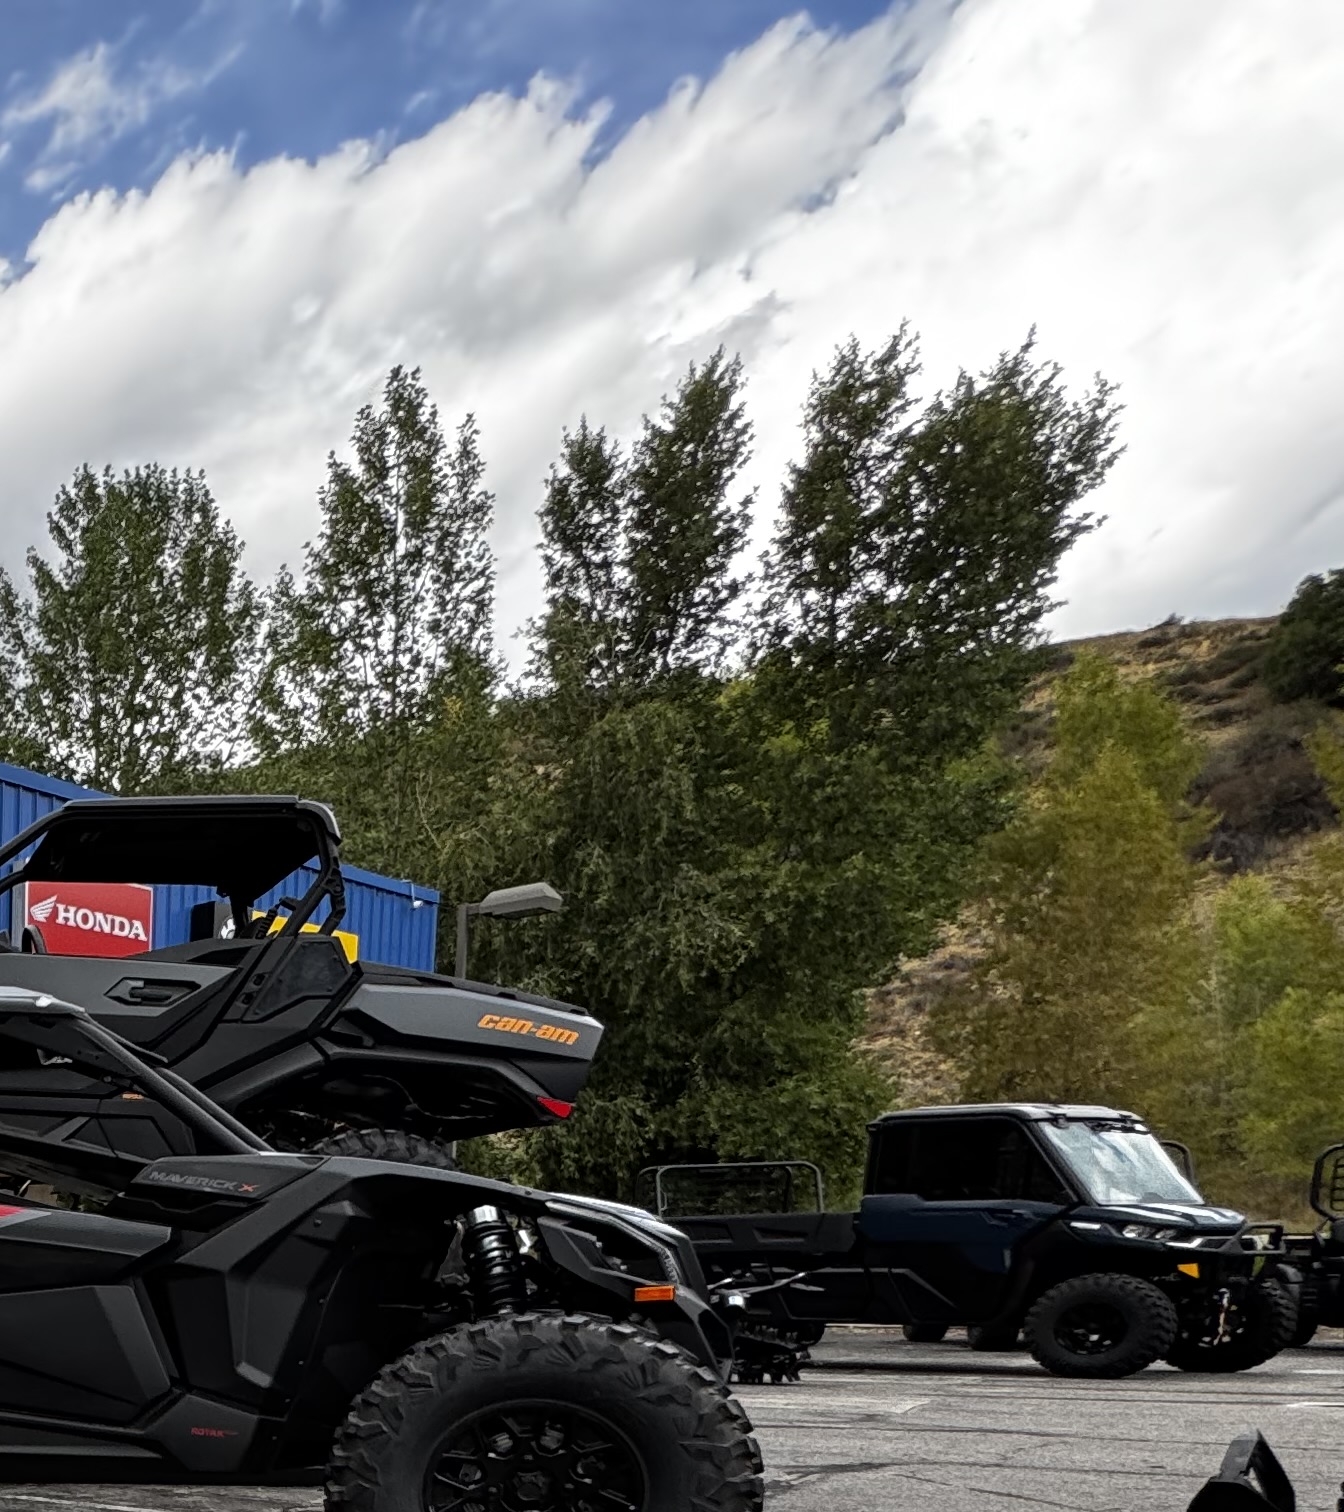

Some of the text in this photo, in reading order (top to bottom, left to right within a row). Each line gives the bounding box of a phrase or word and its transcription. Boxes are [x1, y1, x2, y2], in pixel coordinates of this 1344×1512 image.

[55, 903, 148, 942] HONDA
[477, 1014, 579, 1045] can-am
[149, 1171, 237, 1190] MAVERICK
